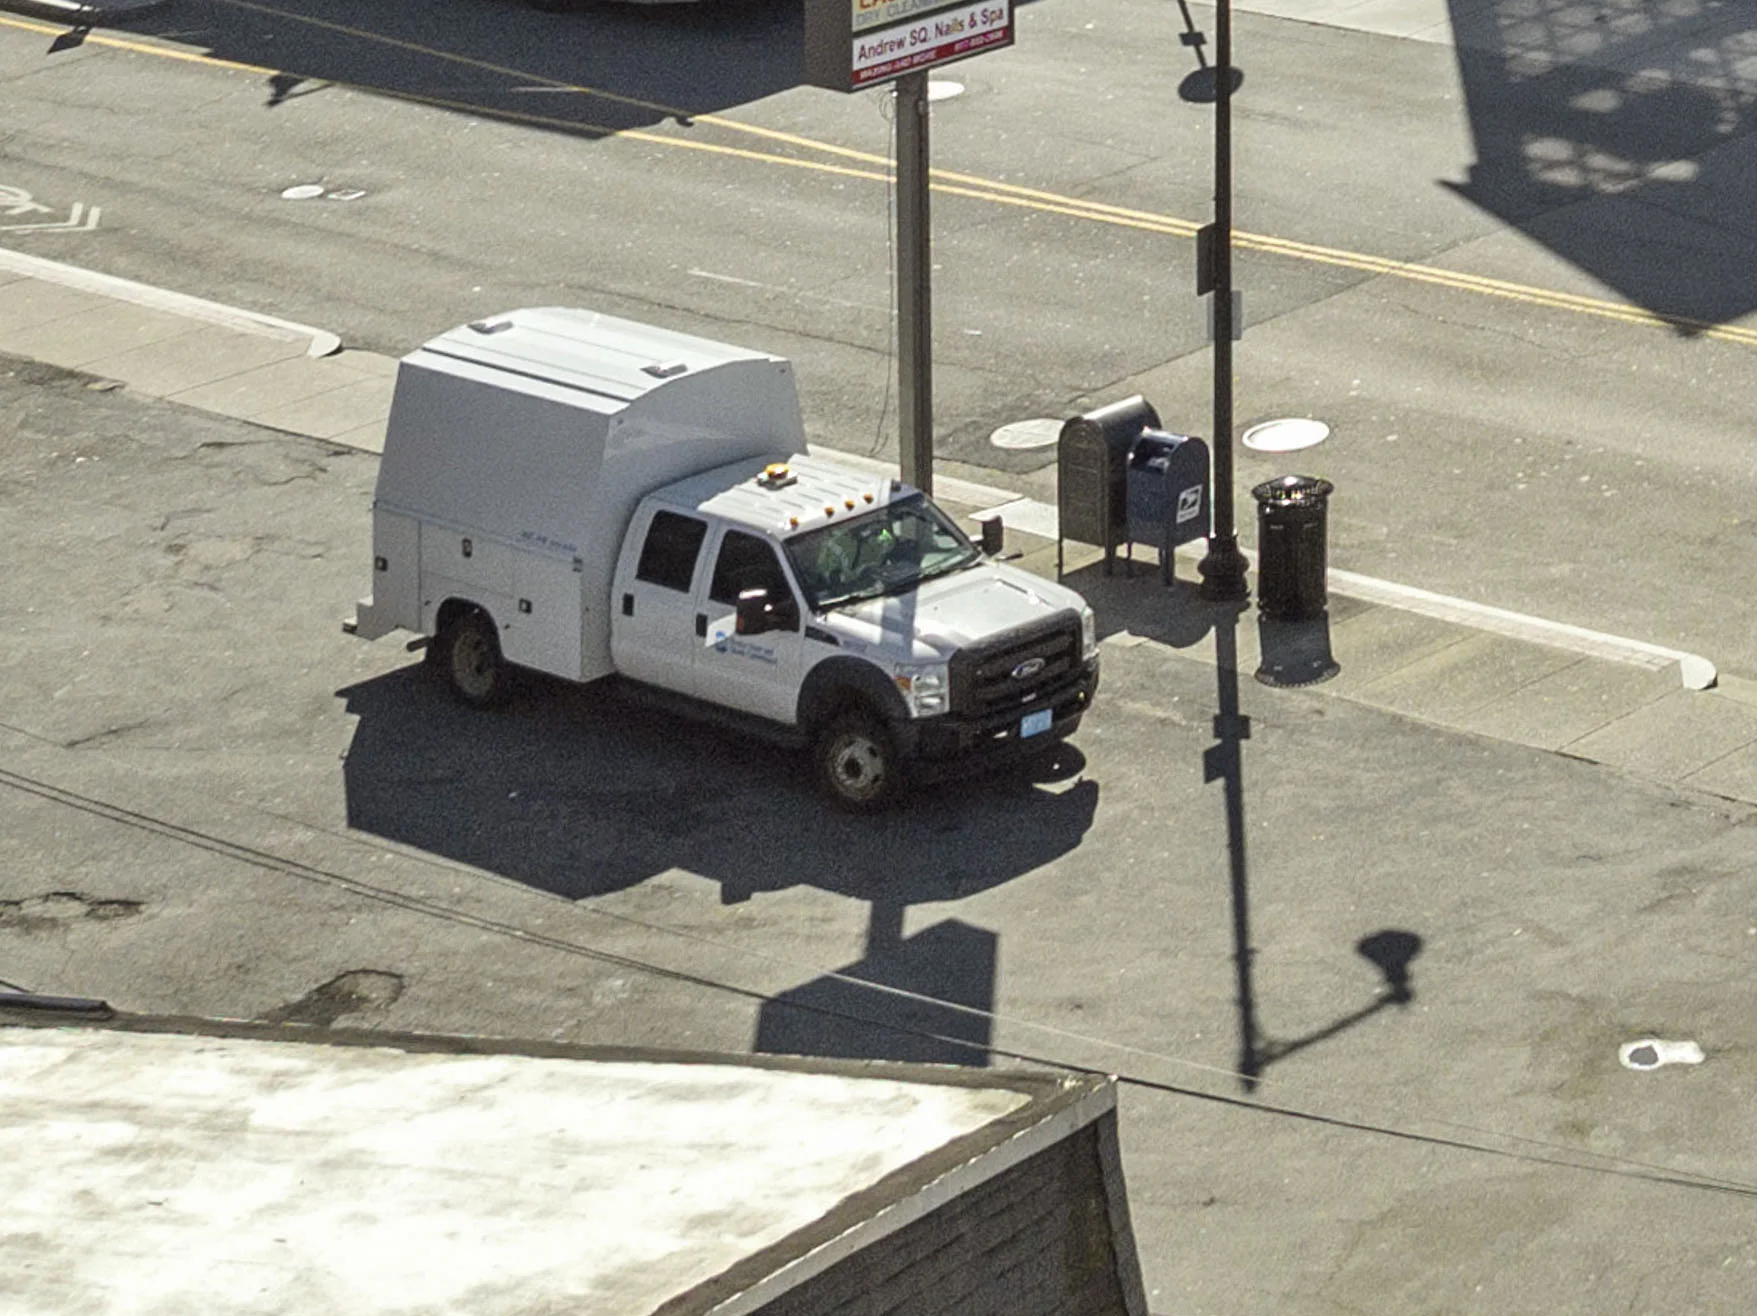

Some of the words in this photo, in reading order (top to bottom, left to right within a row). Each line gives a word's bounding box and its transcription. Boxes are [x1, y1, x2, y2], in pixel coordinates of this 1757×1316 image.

[856, 10, 881, 27] DRY
[858, 35, 907, 61] Andrew
[910, 25, 932, 47] SQ.
[935, 18, 966, 40] Nails
[968, 12, 977, 29] &
[981, 6, 1004, 27] Spa
